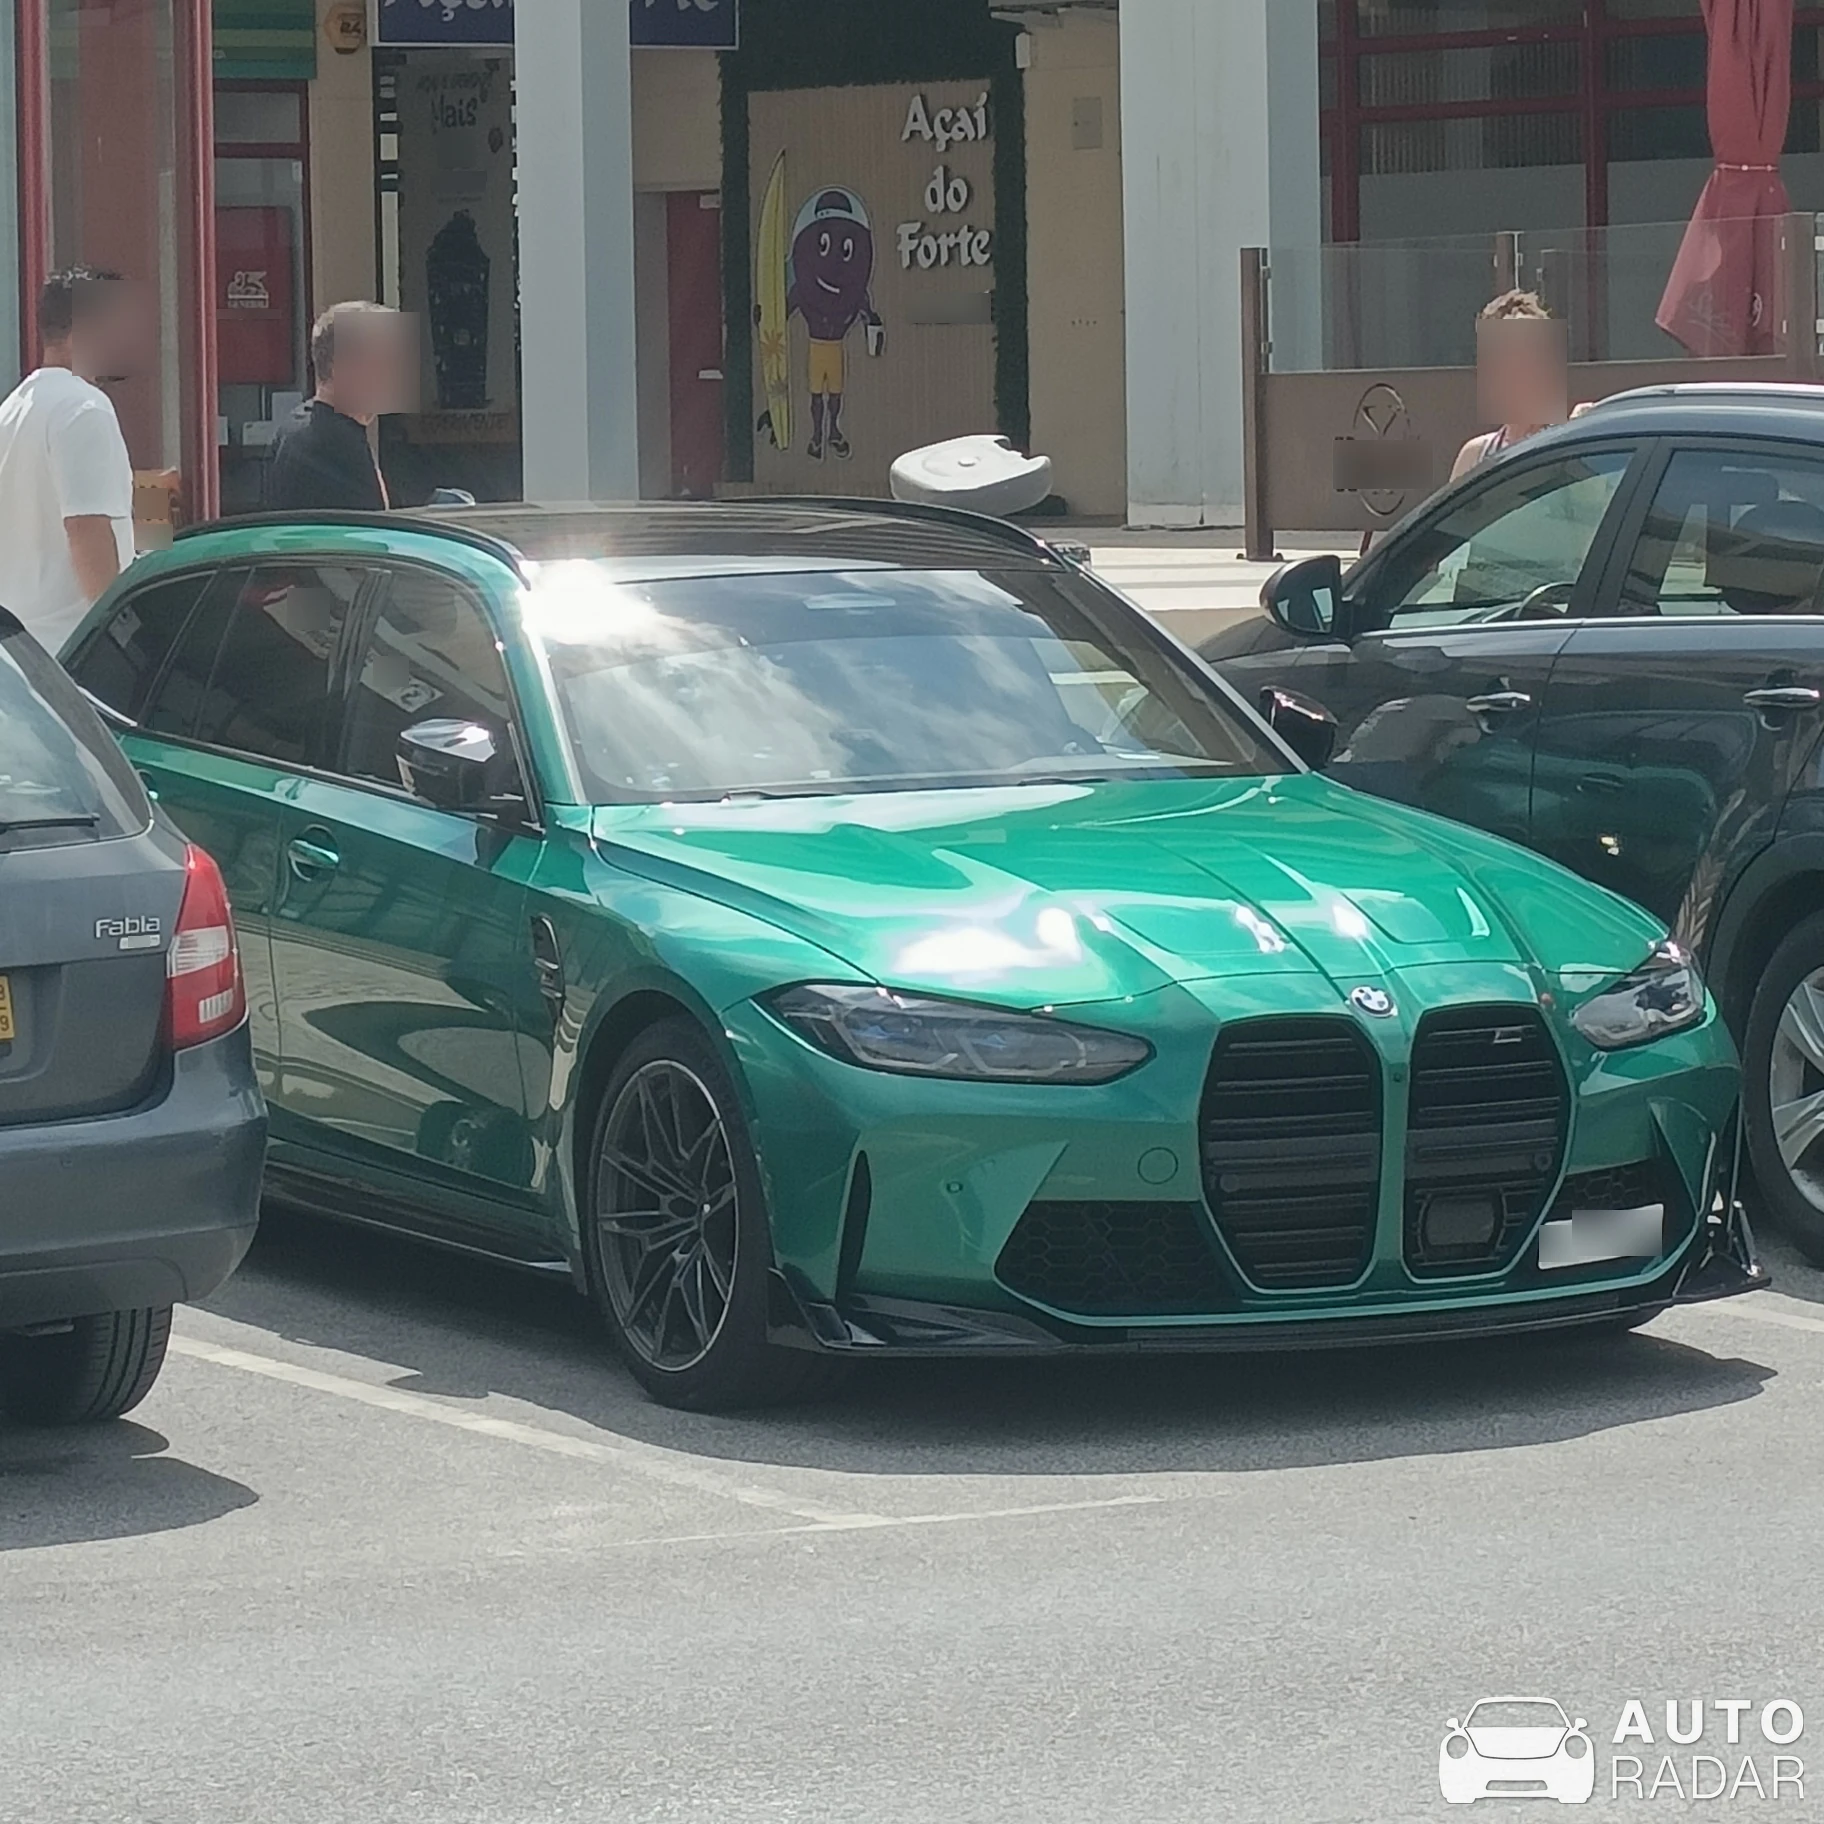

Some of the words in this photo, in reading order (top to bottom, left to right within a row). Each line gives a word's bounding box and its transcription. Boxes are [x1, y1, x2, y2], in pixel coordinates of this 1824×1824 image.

[901, 92, 988, 152] Açaí
[924, 166, 968, 214] do
[896, 222, 991, 269] Forte
